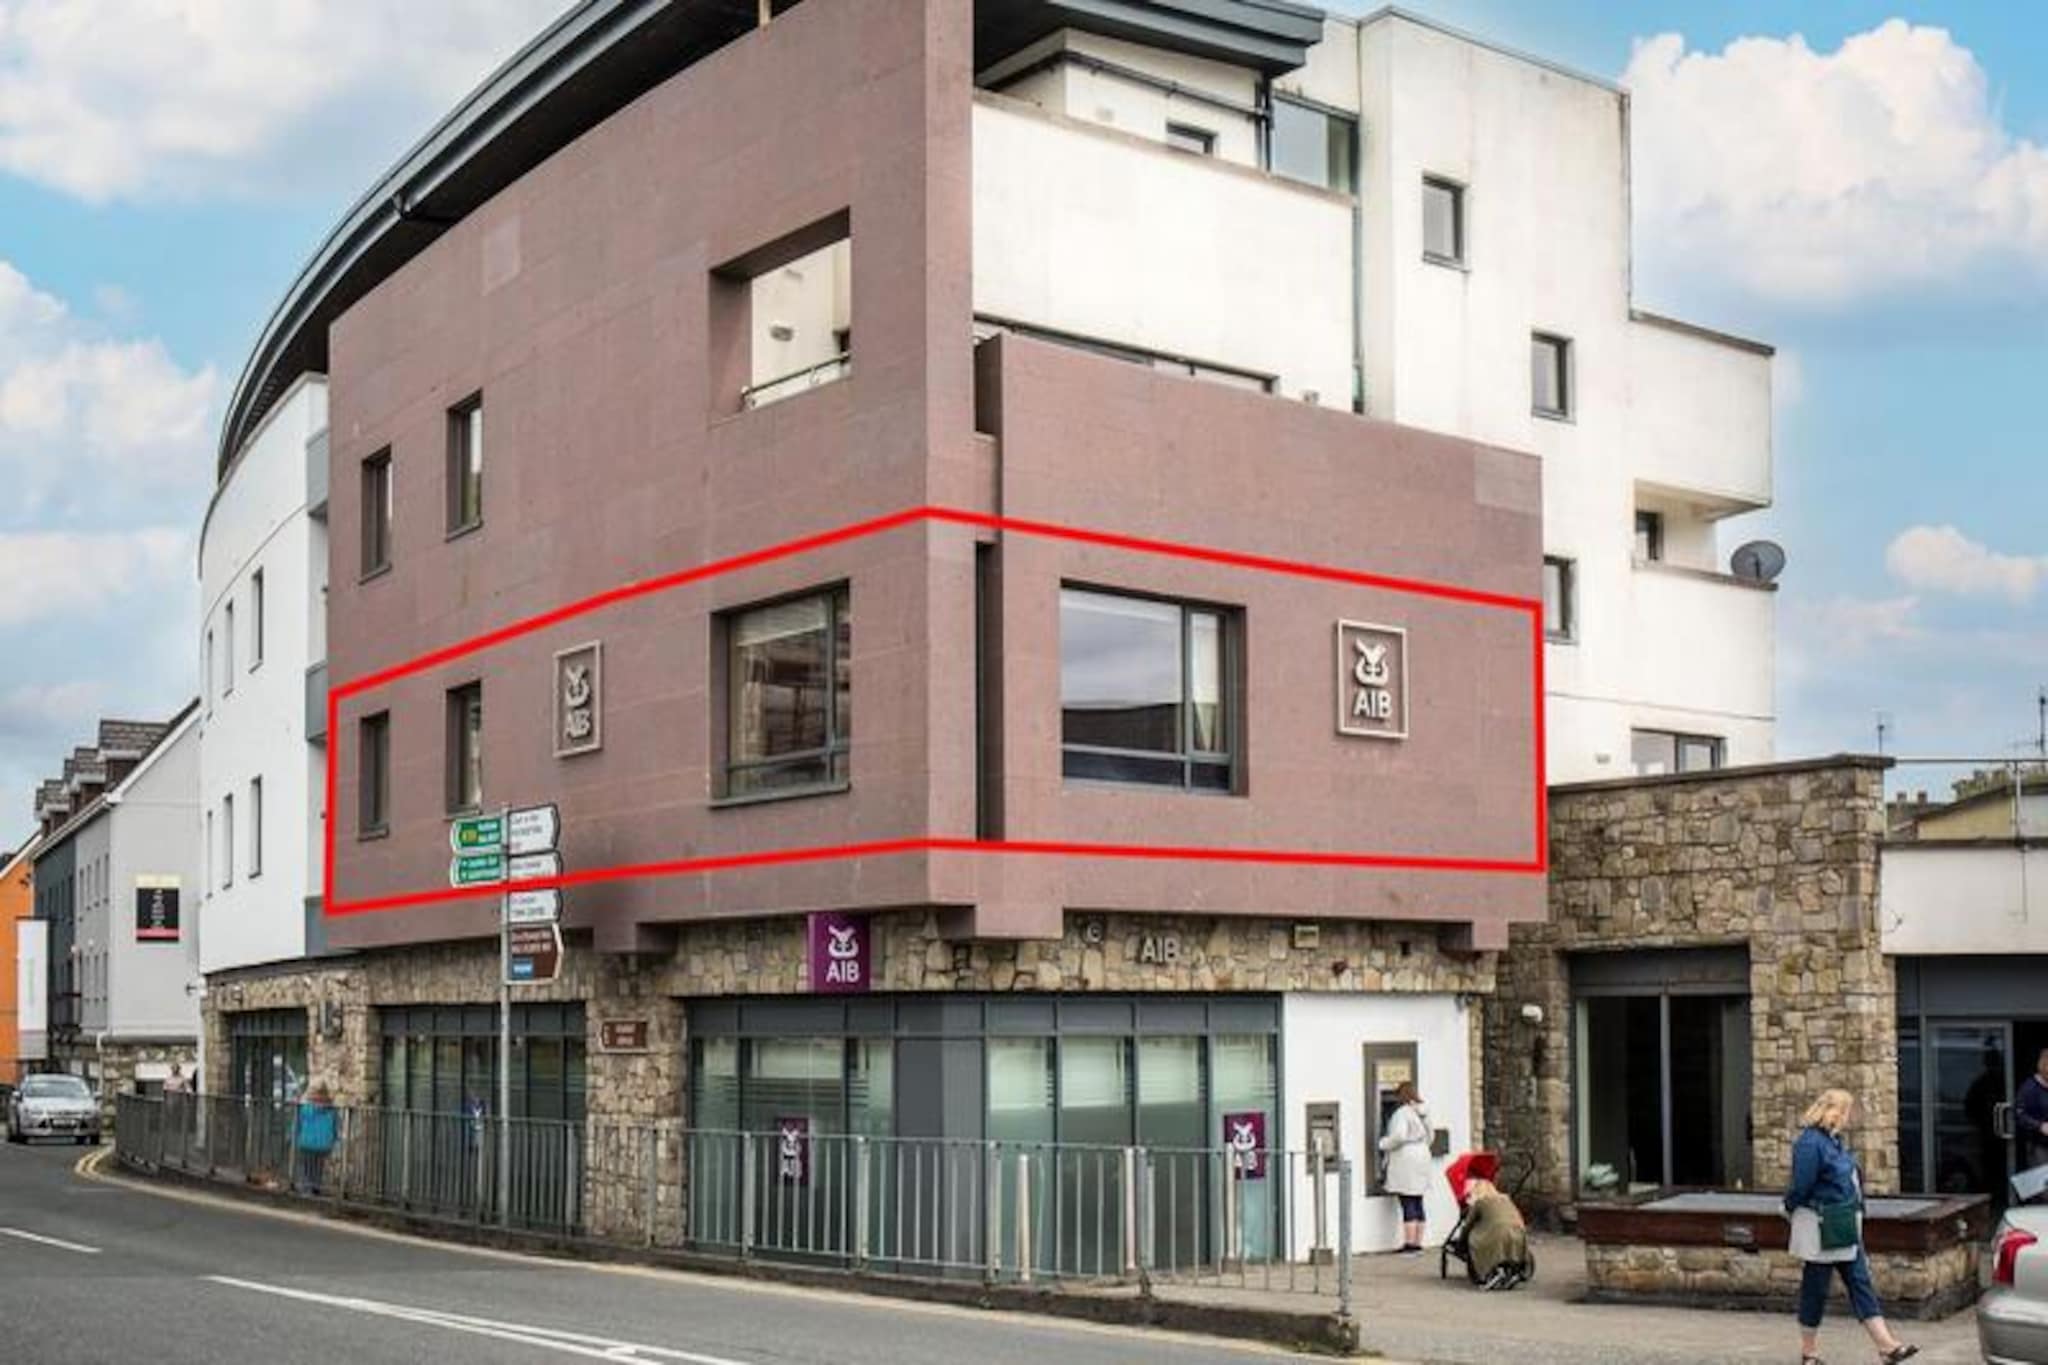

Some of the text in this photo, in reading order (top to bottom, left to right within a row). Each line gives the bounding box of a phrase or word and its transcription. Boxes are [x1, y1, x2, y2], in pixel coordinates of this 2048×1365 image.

[1354, 690, 1392, 719] AIB
[1141, 934, 1180, 962] AIB
[825, 960, 860, 983] AIB
